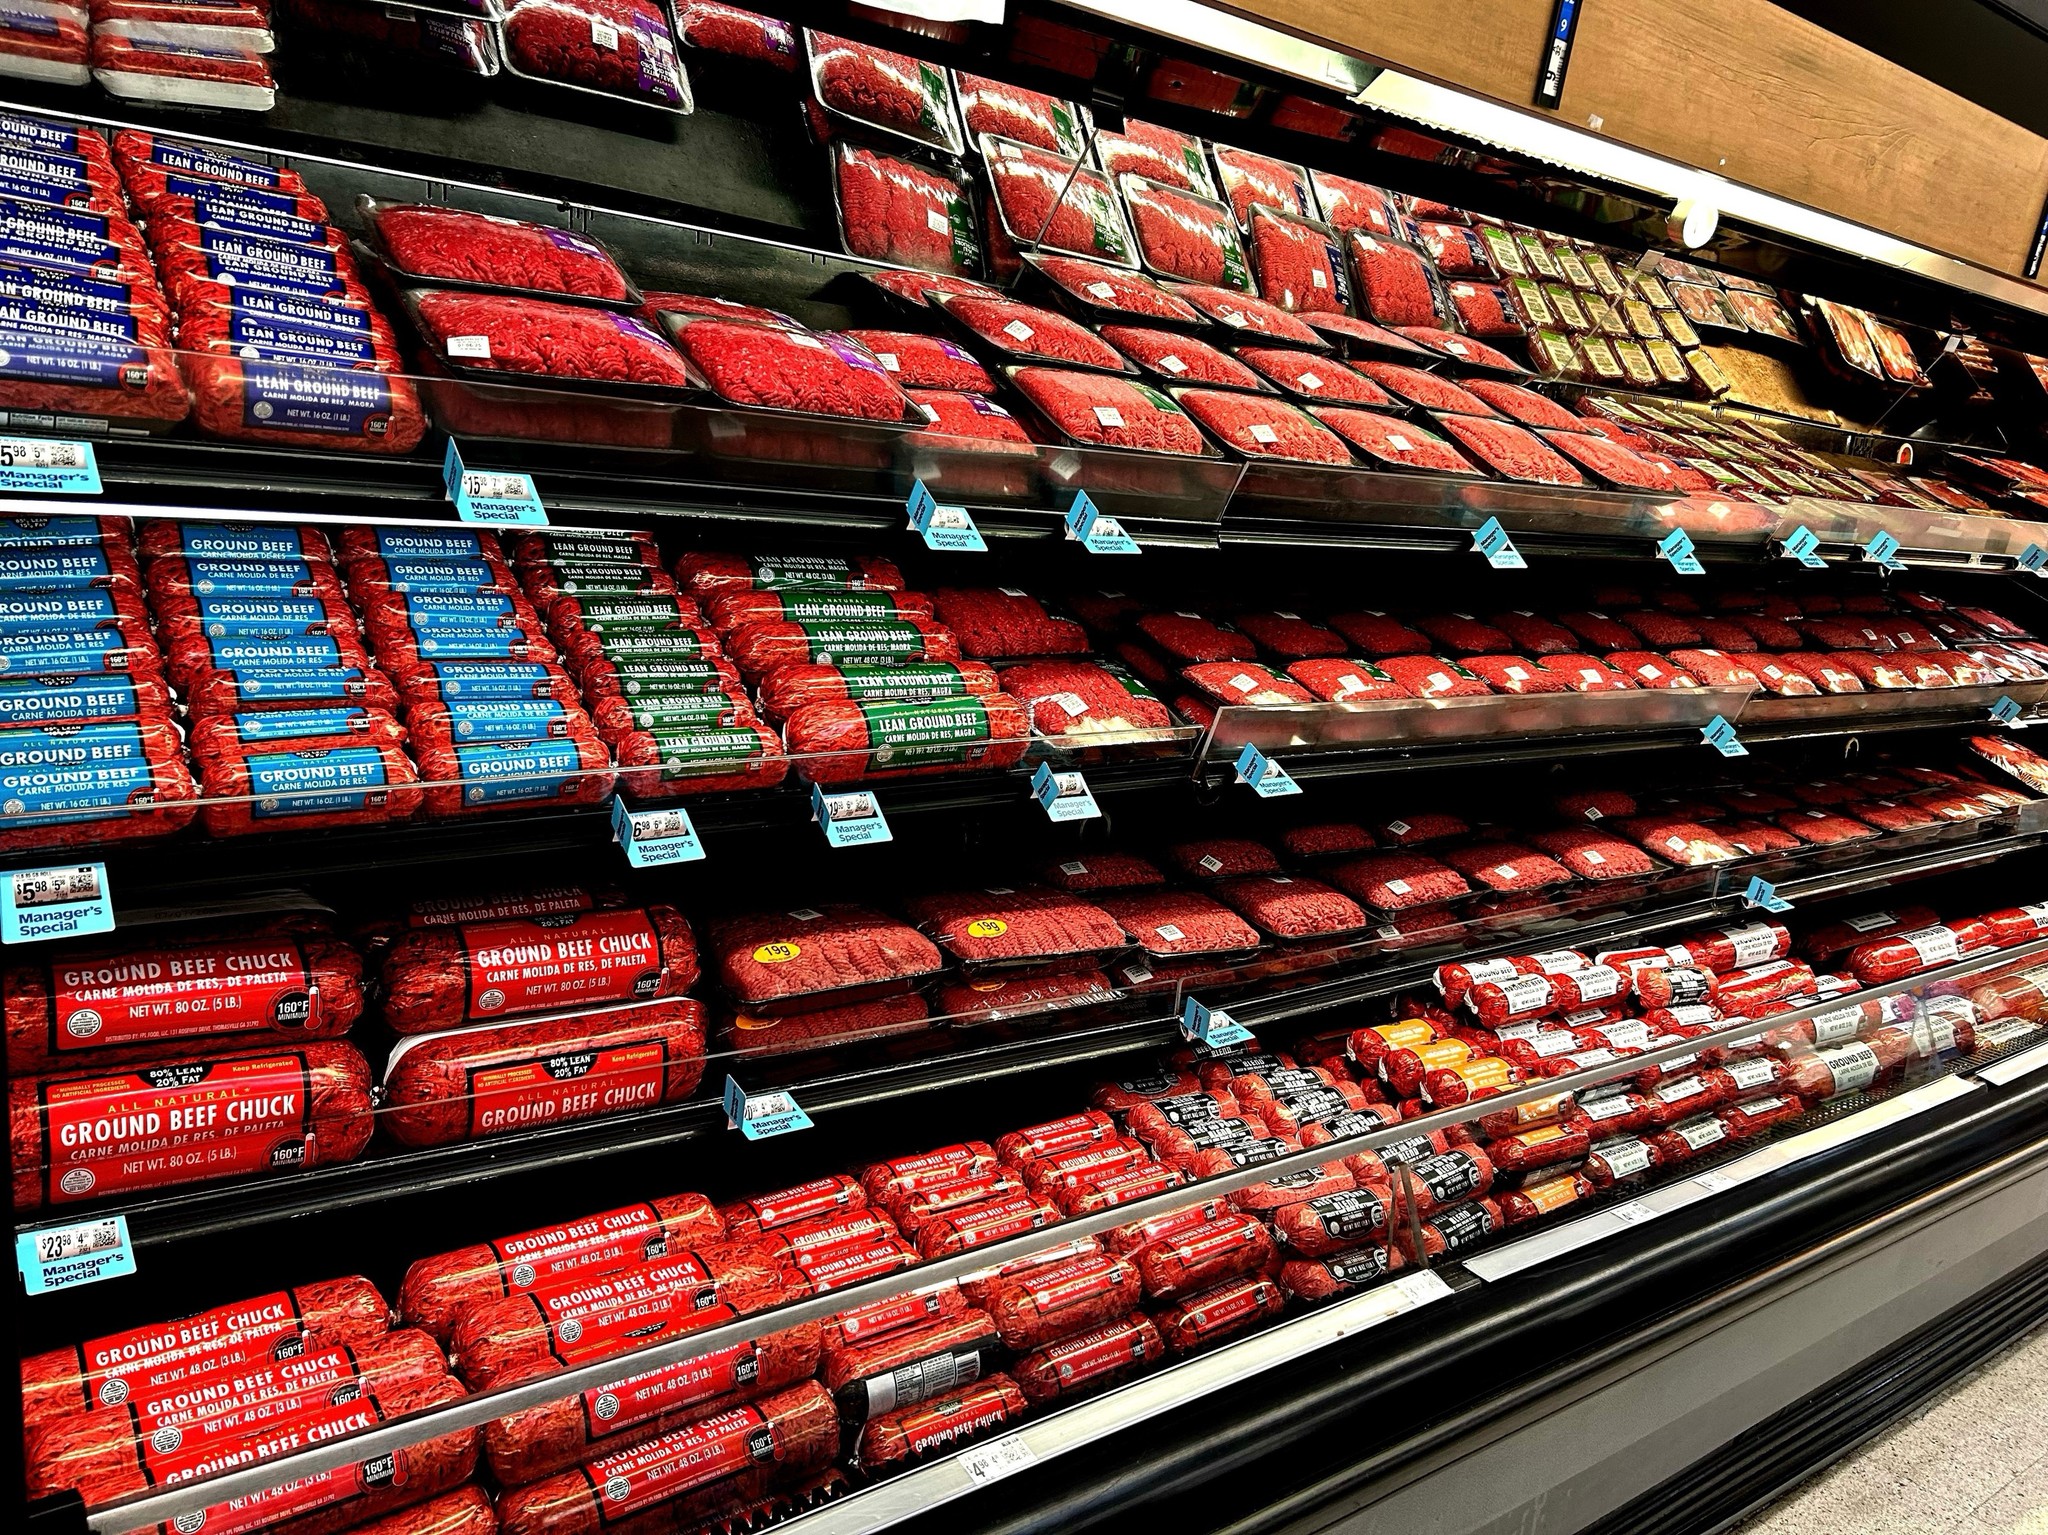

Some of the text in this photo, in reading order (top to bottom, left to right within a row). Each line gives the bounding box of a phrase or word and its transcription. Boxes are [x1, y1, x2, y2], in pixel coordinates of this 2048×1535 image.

[163, 153, 270, 186] LEAN GROUND BEEF
[26, 310, 125, 337] GROUND BEEF
[256, 376, 380, 400] LEAN GROUND BEEF
[0, 470, 89, 481] Manager's
[0, 479, 63, 489] Special
[471, 502, 536, 512] Manager's
[473, 511, 519, 520] Special
[385, 537, 473, 548] GROUND BEEF
[931, 531, 978, 541] Manager's
[935, 539, 968, 547] Special
[1090, 538, 1131, 546] Manager's
[191, 539, 293, 552] GROUND BEEF
[589, 605, 672, 615] LEAN GROUND BEEF
[794, 604, 886, 617] LEAN GROUND BEEF
[879, 713, 977, 733] LEAN GROUND BEEF
[468, 755, 571, 774] GROUND BEEF
[3, 768, 139, 788] GROUND BEEF
[260, 764, 375, 782] GROUND BEEF
[272, 777, 367, 791] CARNE MOLIDA DE RES
[1053, 800, 1093, 810] Manager's
[1056, 808, 1085, 817] Special
[835, 822, 883, 834] Manager's
[839, 832, 872, 842] Special
[638, 840, 694, 853] Manager's
[641, 850, 681, 862] Special
[18, 906, 102, 924] Manager's
[20, 920, 78, 936] Special
[477, 932, 652, 968] GROUND BEEF CHUCK
[64, 952, 294, 986] GROUND BEEF CHUCK
[75, 972, 288, 1002] CARNE MOLIDA DE RES, DE PALETA
[129, 997, 242, 1018] NET WT. 80 OZ. (5 LB.)
[277, 1000, 309, 1014] 160°F
[277, 1011, 308, 1020] MINIMUM
[550, 1055, 591, 1068] 80% LEAN
[1829, 1048, 1873, 1070] GROUND BEEF
[150, 1066, 203, 1078] 80% LEAN
[232, 1060, 294, 1073] Keep Refrigerated
[554, 1066, 588, 1079] 20% FAT
[156, 1075, 201, 1088] 20% FAT
[108, 1102, 141, 1113] ALL
[481, 1081, 657, 1128] GROUND BEEF CHUCK
[61, 1094, 296, 1147] GROUND BEEF CHUCK
[751, 1113, 802, 1129] Manager's
[756, 1123, 791, 1135] Special
[895, 1149, 968, 1171] GROUND BEEF CHUCK
[505, 1209, 650, 1255] GROUND BEEF CHUCK
[42, 1253, 124, 1277] Manager's
[809, 1245, 894, 1276] GROUND BEEF CHUCK
[44, 1268, 101, 1287] Special
[549, 1261, 697, 1311] GROUND BEEF CHUCK
[95, 1303, 286, 1366] GROUND BEEF CHUCK
[1051, 1323, 1129, 1357] GROUND BEEF CHUCK
[147, 1353, 341, 1416] GROUND BEEF CHUCK
